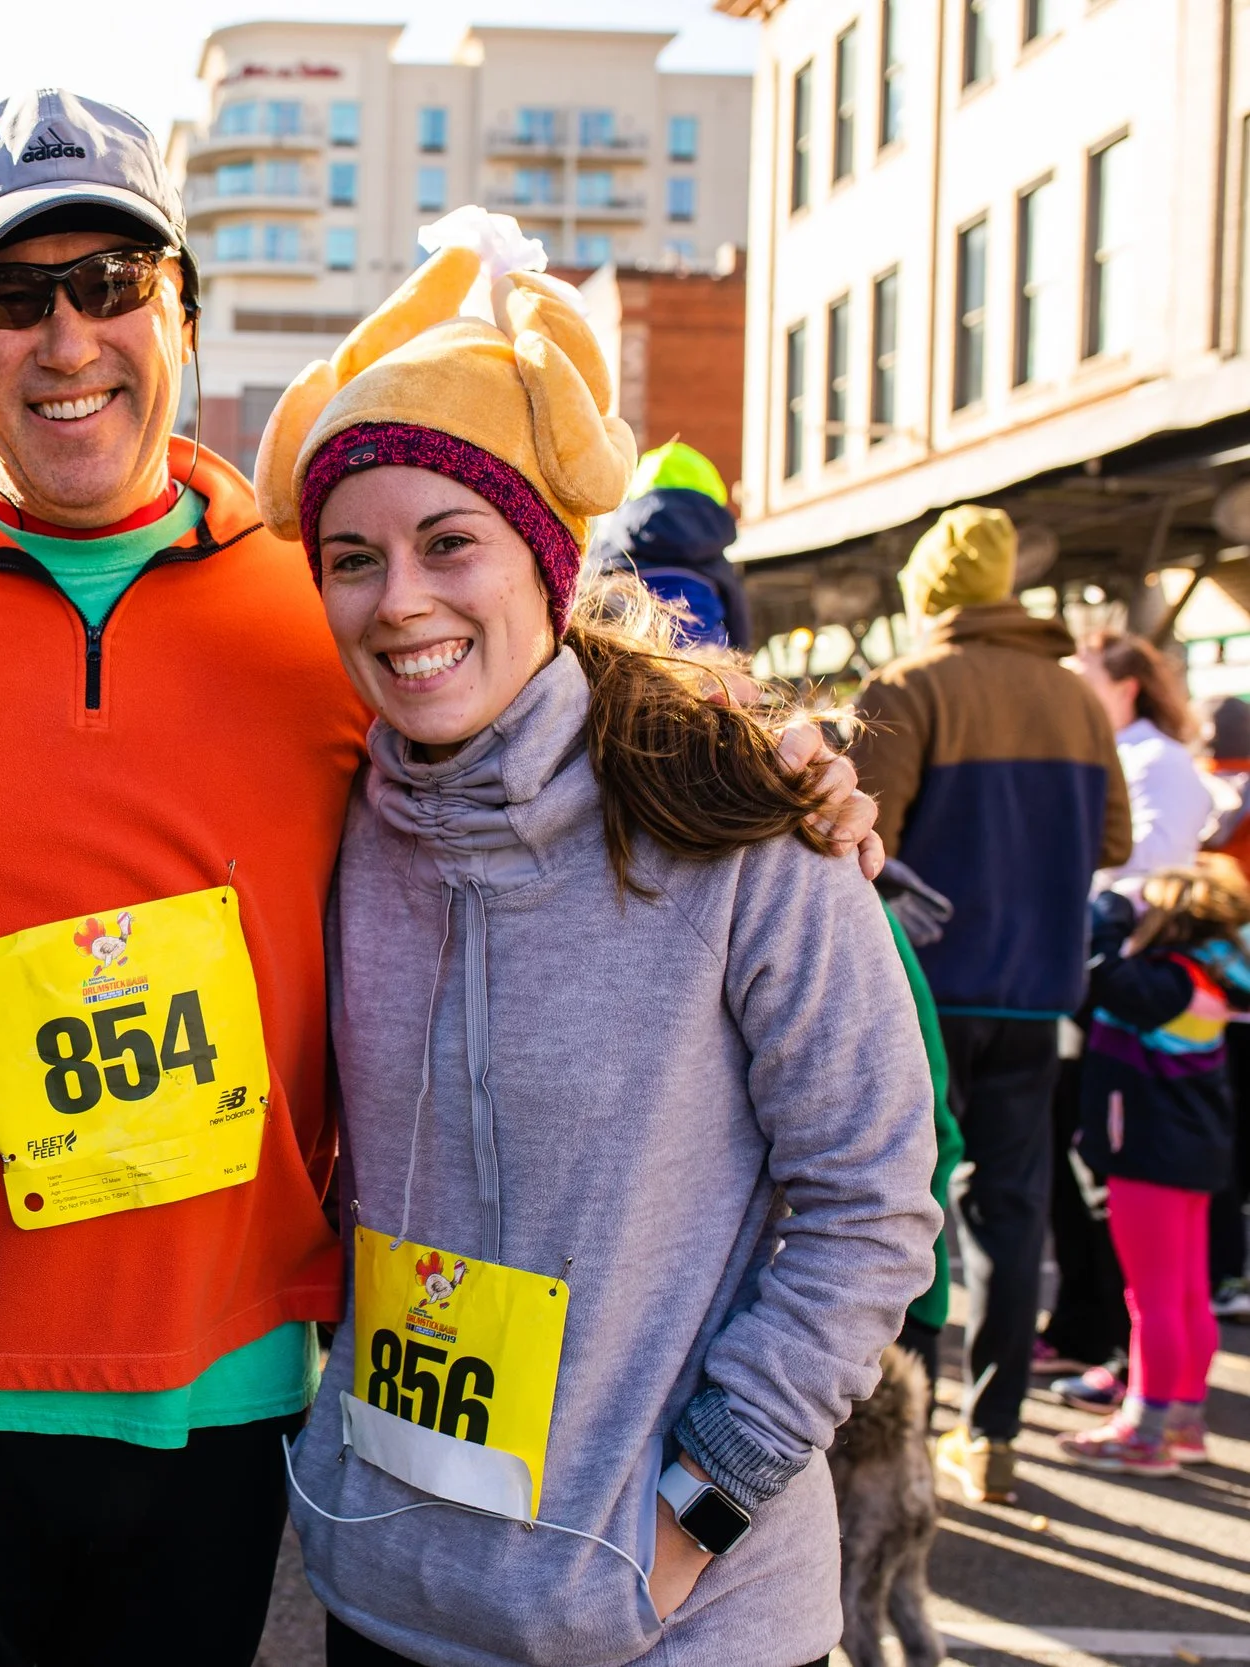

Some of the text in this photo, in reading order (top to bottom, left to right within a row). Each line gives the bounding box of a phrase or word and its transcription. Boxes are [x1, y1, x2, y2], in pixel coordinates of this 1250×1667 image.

[22, 144, 86, 164] adidas
[82, 980, 126, 996] DRUMSTICK
[125, 983, 149, 995] 2019
[36, 989, 218, 1115] 854
[209, 1107, 255, 1126] new balance
[27, 1134, 65, 1152] FLEET
[33, 1145, 63, 1160] FEET
[224, 1163, 247, 1175] No. 854
[406, 1313, 439, 1330] DRUMSTICK
[435, 1332, 456, 1344] 2019
[368, 1329, 495, 1446] 856
